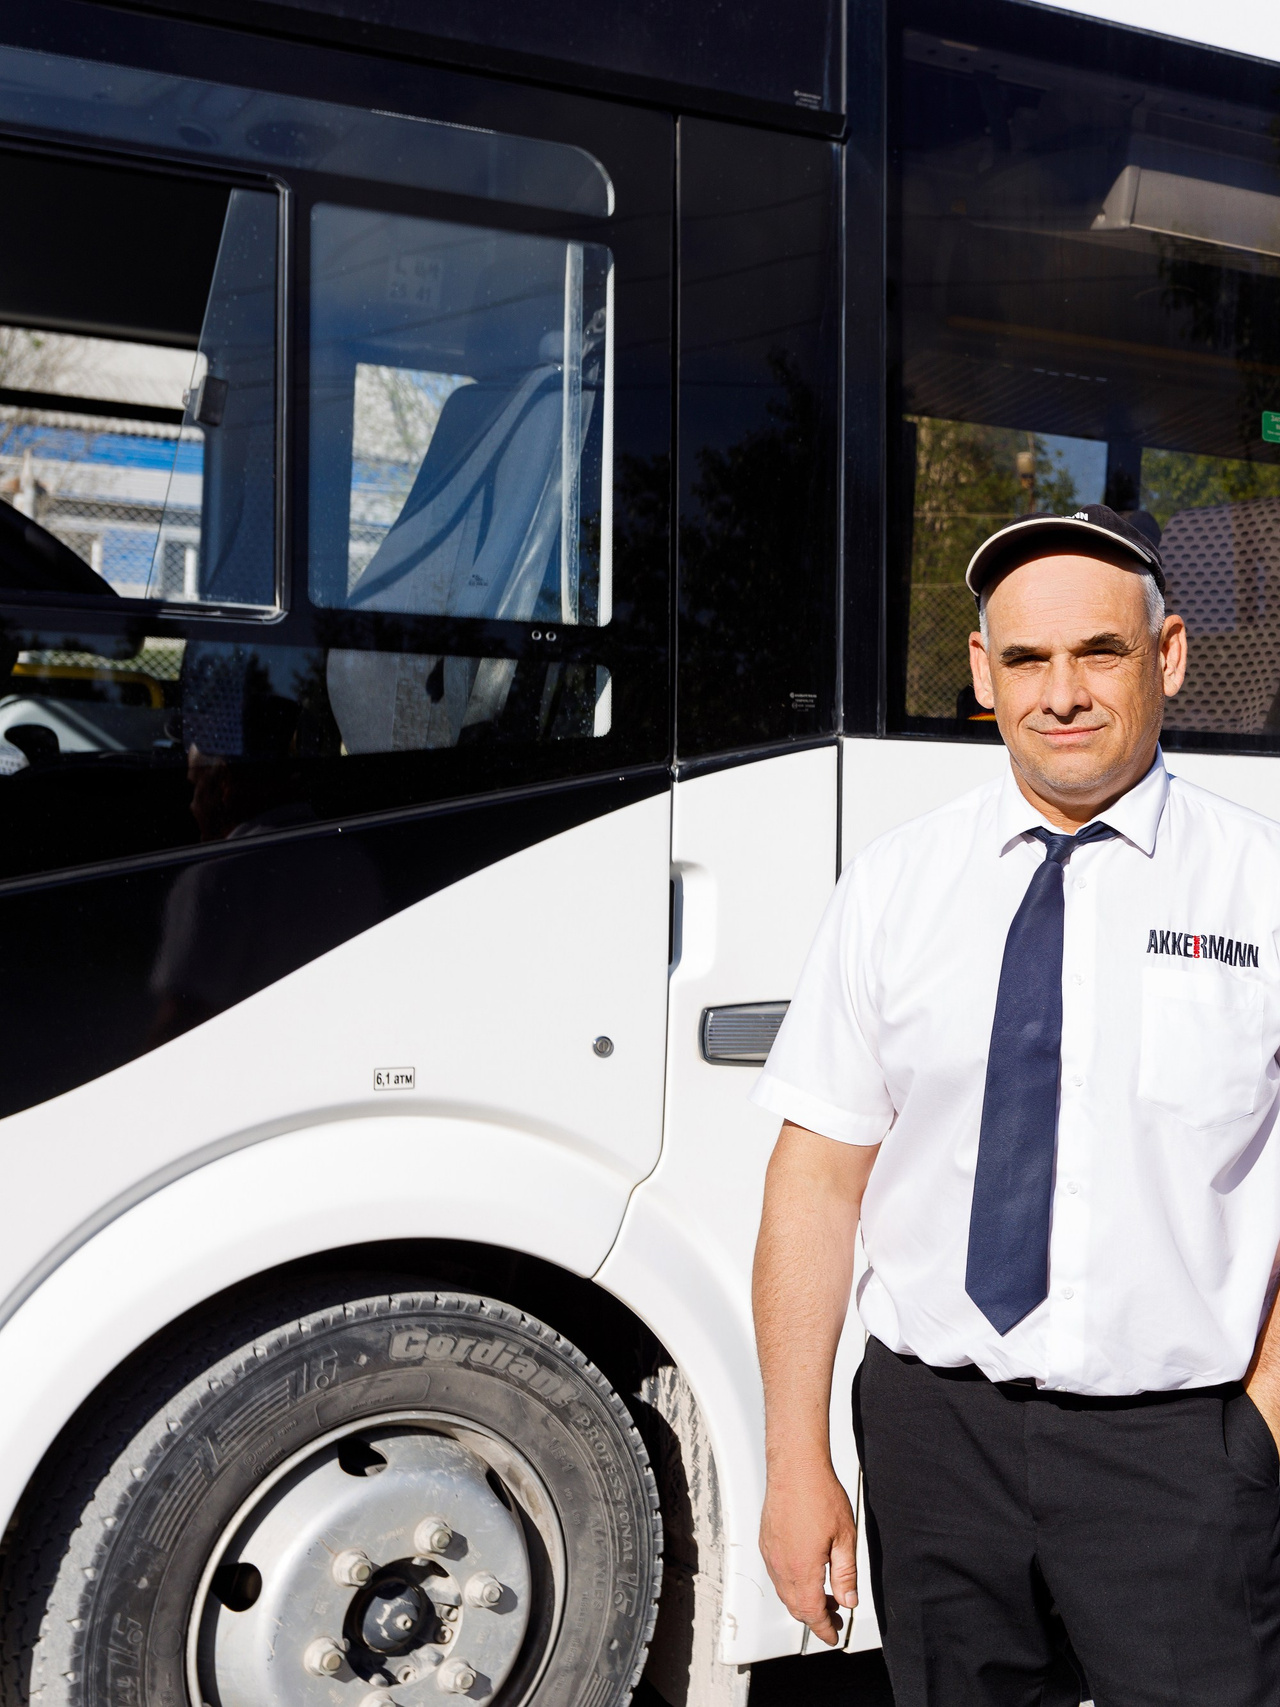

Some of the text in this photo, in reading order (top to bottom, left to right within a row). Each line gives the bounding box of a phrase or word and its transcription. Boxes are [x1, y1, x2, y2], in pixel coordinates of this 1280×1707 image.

[1147, 929, 1259, 968] AKKERMANN
[376, 1072, 412, 1087] 6,1 атм
[389, 1327, 634, 1563] Cordiant PROFESSIONAL
